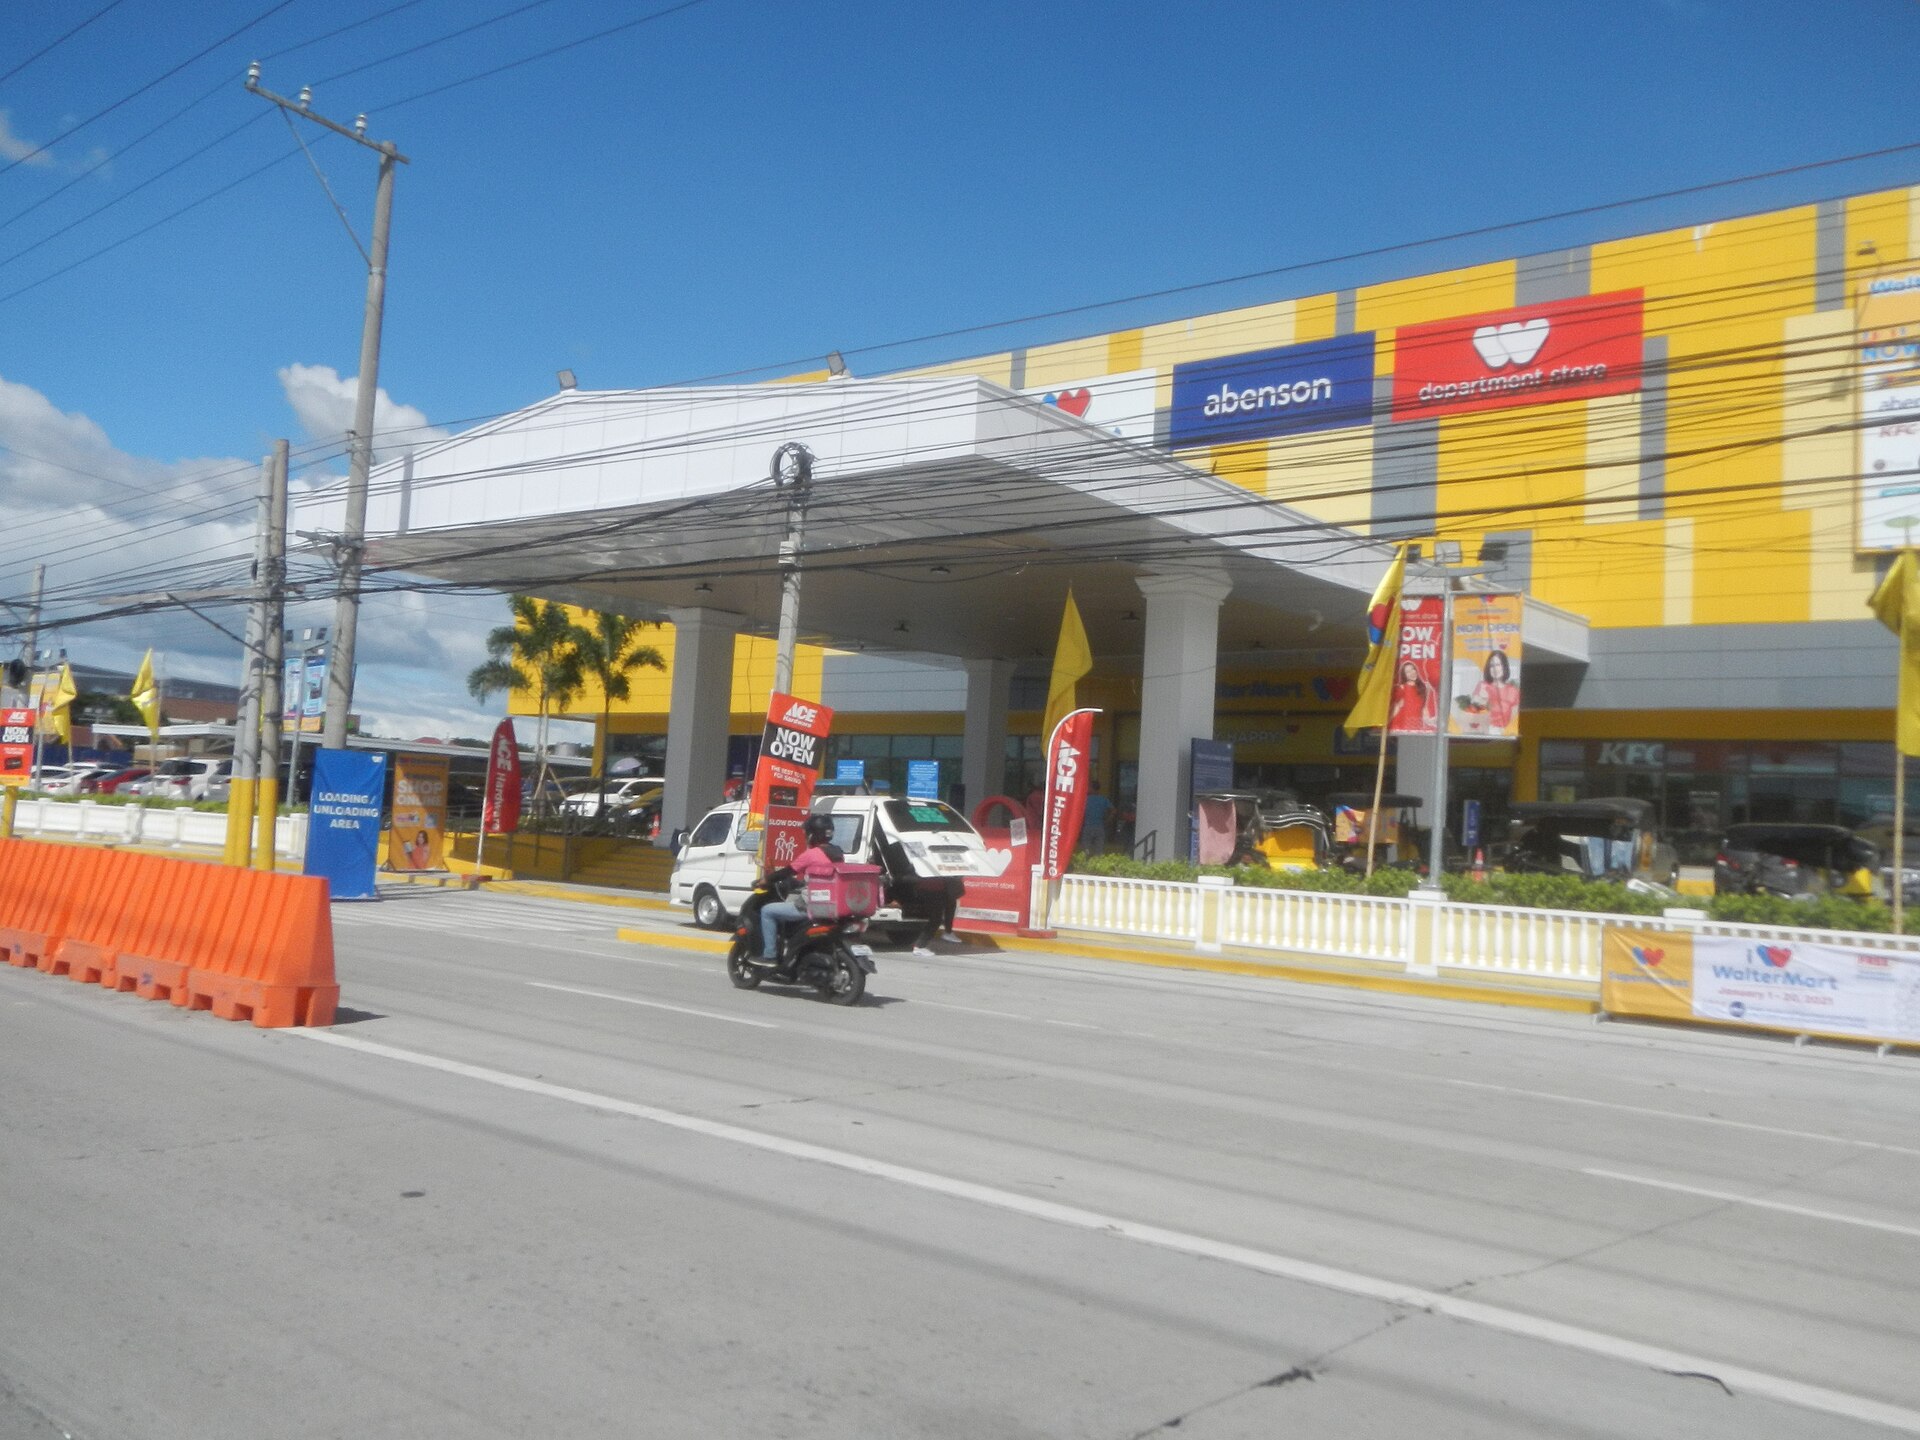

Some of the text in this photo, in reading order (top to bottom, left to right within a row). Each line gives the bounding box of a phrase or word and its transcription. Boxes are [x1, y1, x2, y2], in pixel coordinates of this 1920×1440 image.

[1419, 363, 1607, 401] department store
[1204, 378, 1331, 416] abenson
[1401, 625, 1434, 641] OW
[1400, 643, 1435, 659] PEN
[785, 702, 818, 723] ACE
[2, 734, 29, 743] OPEN
[5, 726, 29, 736] NOW
[775, 727, 815, 751] NOW
[770, 741, 815, 765] OPEN
[1598, 742, 1665, 766] KFC
[1055, 739, 1081, 793] ACE
[398, 780, 443, 793] SHOP
[319, 792, 369, 804] LOADING
[313, 805, 379, 817] UNLOADING
[329, 818, 359, 829] AREA
[769, 819, 787, 827] SLOW
[1048, 796, 1067, 877] Hardware
[1712, 965, 1838, 990] WalterMart
